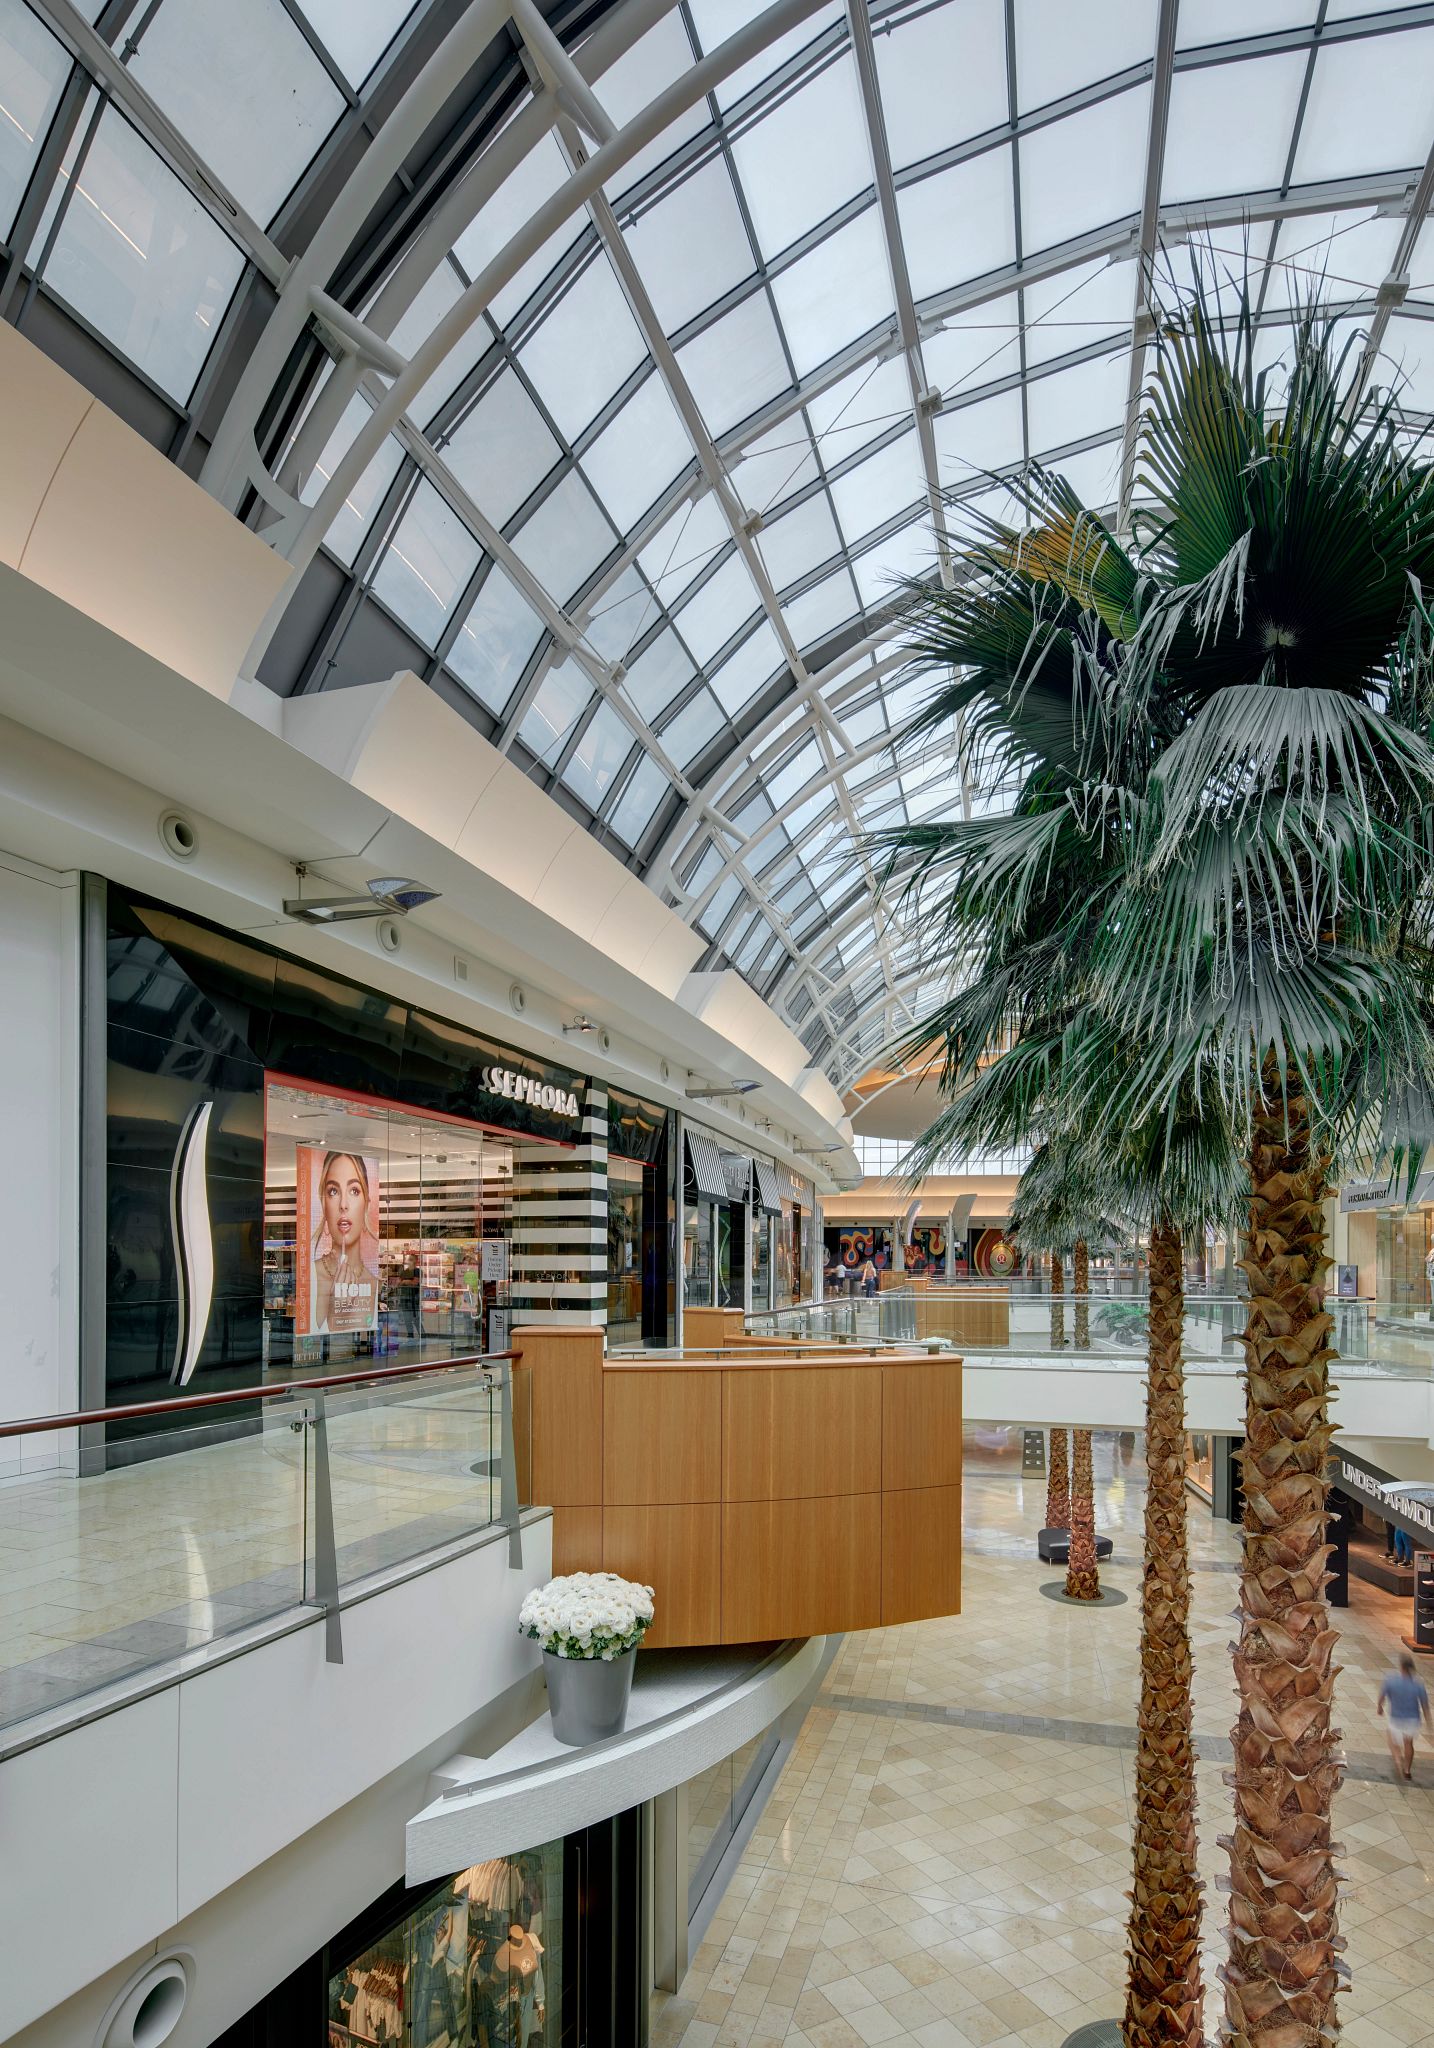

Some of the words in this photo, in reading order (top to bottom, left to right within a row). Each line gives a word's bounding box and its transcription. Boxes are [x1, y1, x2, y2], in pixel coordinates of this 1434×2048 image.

[488, 1066, 580, 1117] SEPHORA
[334, 1298, 371, 1308] BEAUTY
[293, 1351, 322, 1362] BETTER
[1342, 1460, 1382, 1501] UNDER
